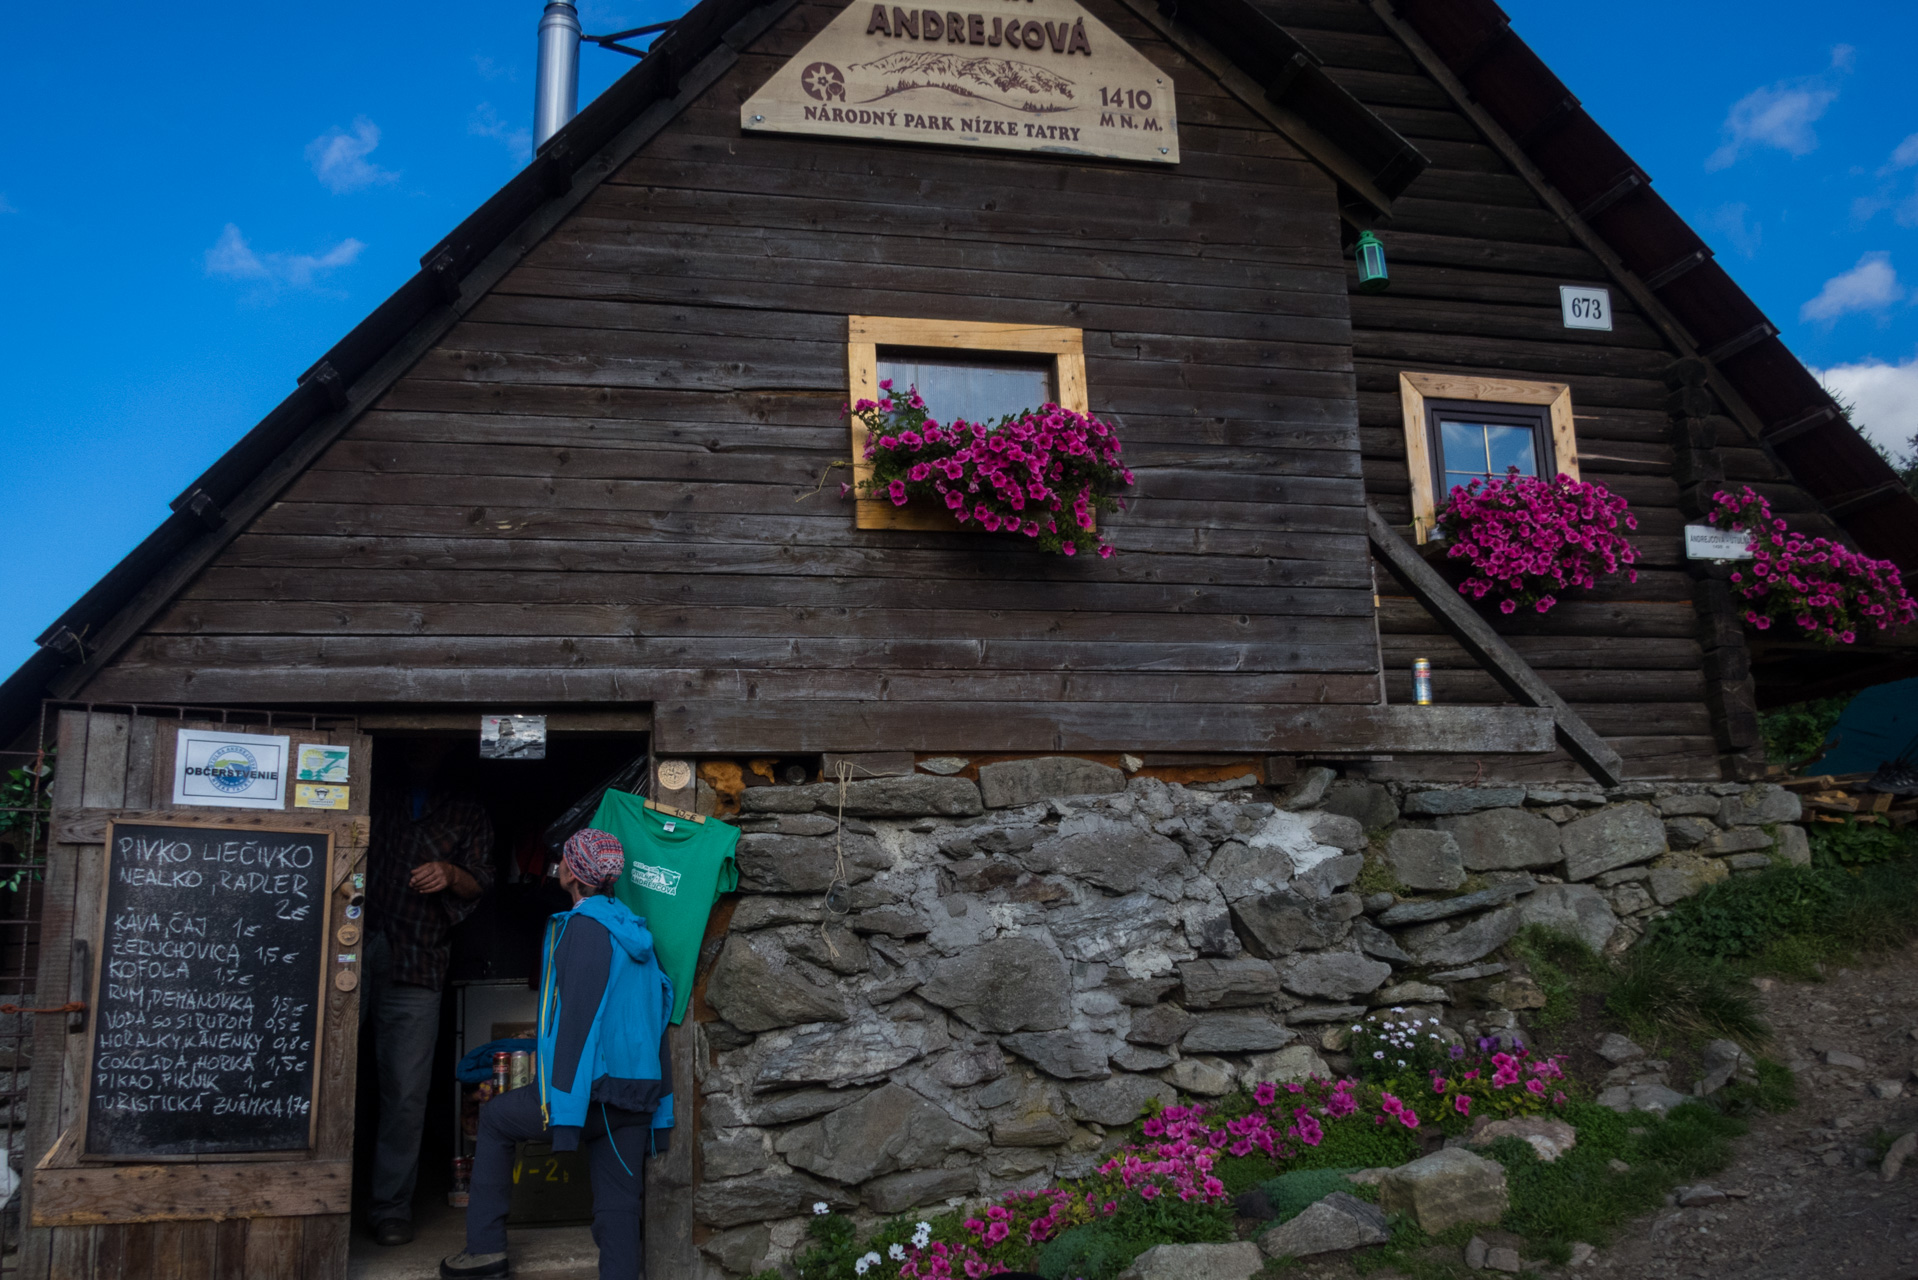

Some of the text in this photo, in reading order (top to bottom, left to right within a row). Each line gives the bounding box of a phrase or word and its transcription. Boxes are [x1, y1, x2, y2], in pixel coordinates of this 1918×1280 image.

[866, 4, 1092, 55] ANDREJCOVÁ
[1098, 86, 1152, 110] 1410
[803, 103, 1081, 141] NÁRODNÝ PARK NÍZKE TATRY
[1099, 113, 1115, 127] M
[1142, 117, 1163, 131] M.
[1571, 297, 1602, 320] 673
[185, 765, 278, 780] OBČERSTVENIE
[118, 837, 314, 869] PIVKO LIEČIVKO
[111, 933, 241, 968] ŽERUCHOVICA
[108, 956, 190, 979] KOFOLA
[104, 1010, 146, 1030] VODA
[176, 1012, 254, 1030] SIRUPOM
[213, 1093, 283, 1118] ZNÁMKA
